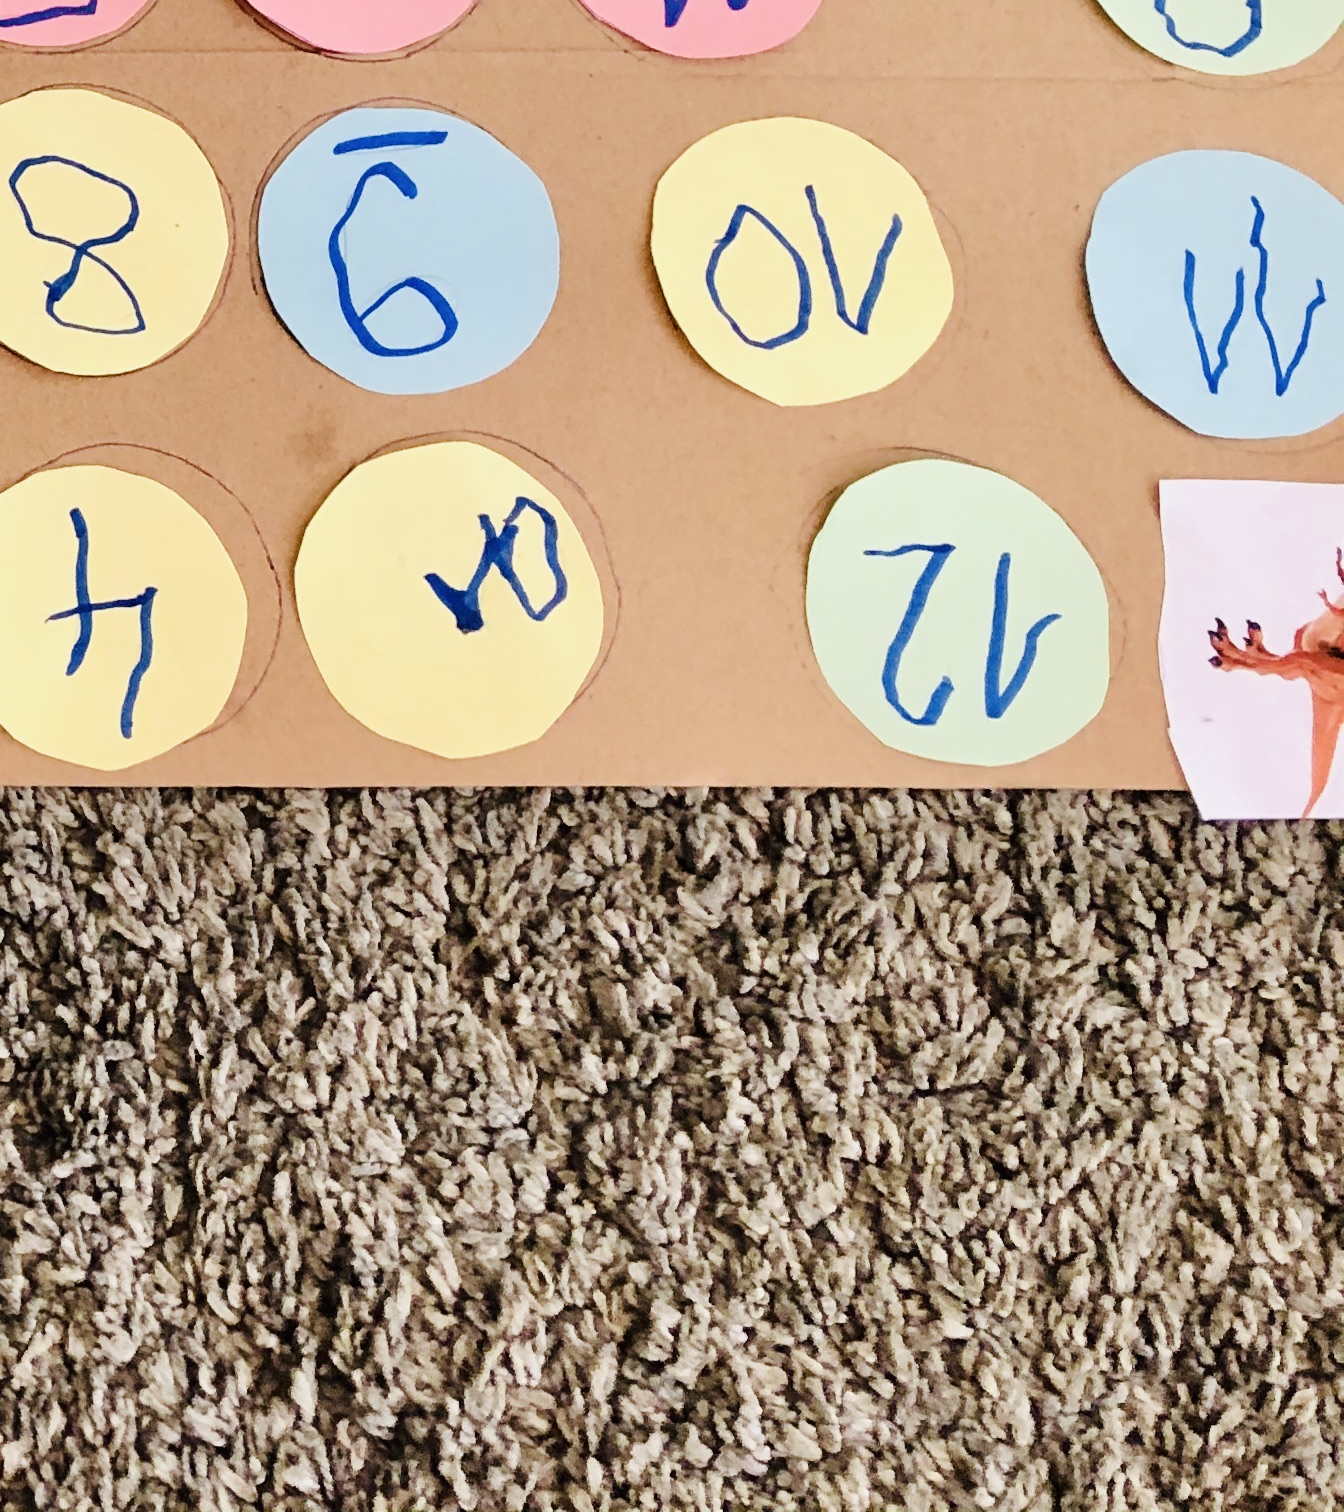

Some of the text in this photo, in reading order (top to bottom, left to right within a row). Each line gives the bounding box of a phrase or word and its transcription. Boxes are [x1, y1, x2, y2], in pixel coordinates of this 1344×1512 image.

[9, 156, 146, 334] 8
[706, 185, 902, 350] 10
[46, 508, 157, 738] 4
[862, 542, 1060, 727] 12
